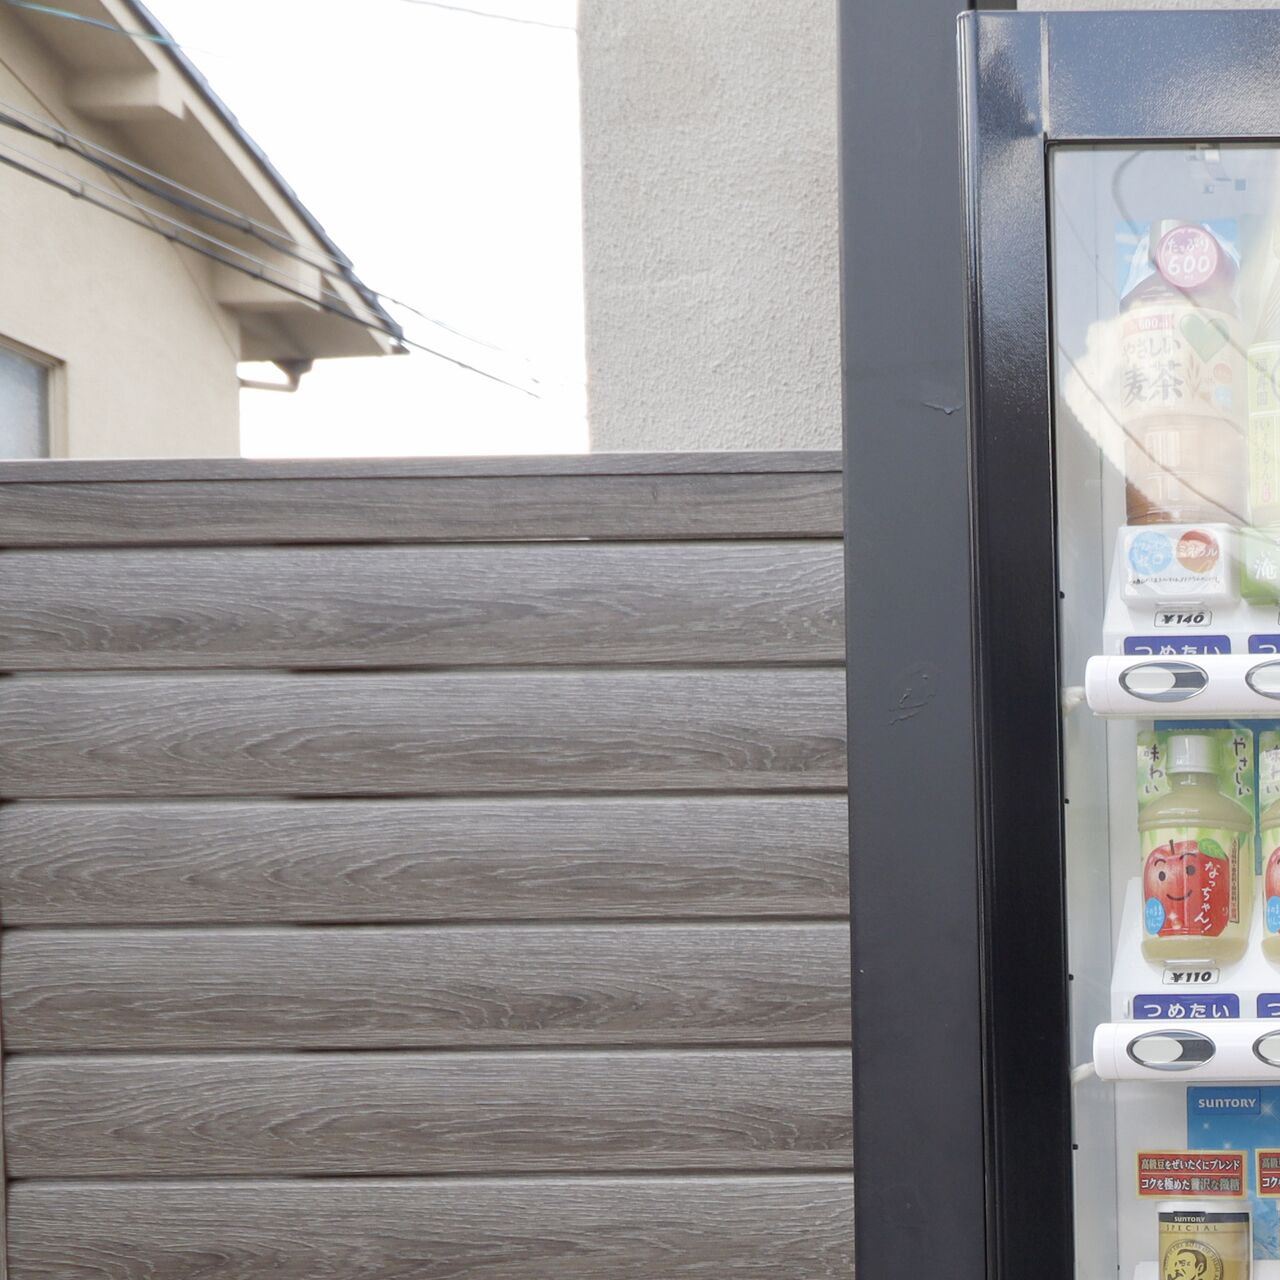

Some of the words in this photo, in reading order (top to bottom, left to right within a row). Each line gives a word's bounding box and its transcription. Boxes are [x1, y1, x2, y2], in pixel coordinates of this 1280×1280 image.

[1161, 613, 1205, 624] ¥140
[1143, 1002, 1230, 1018] つめたい
[1198, 1098, 1256, 1108] SUNTORY
